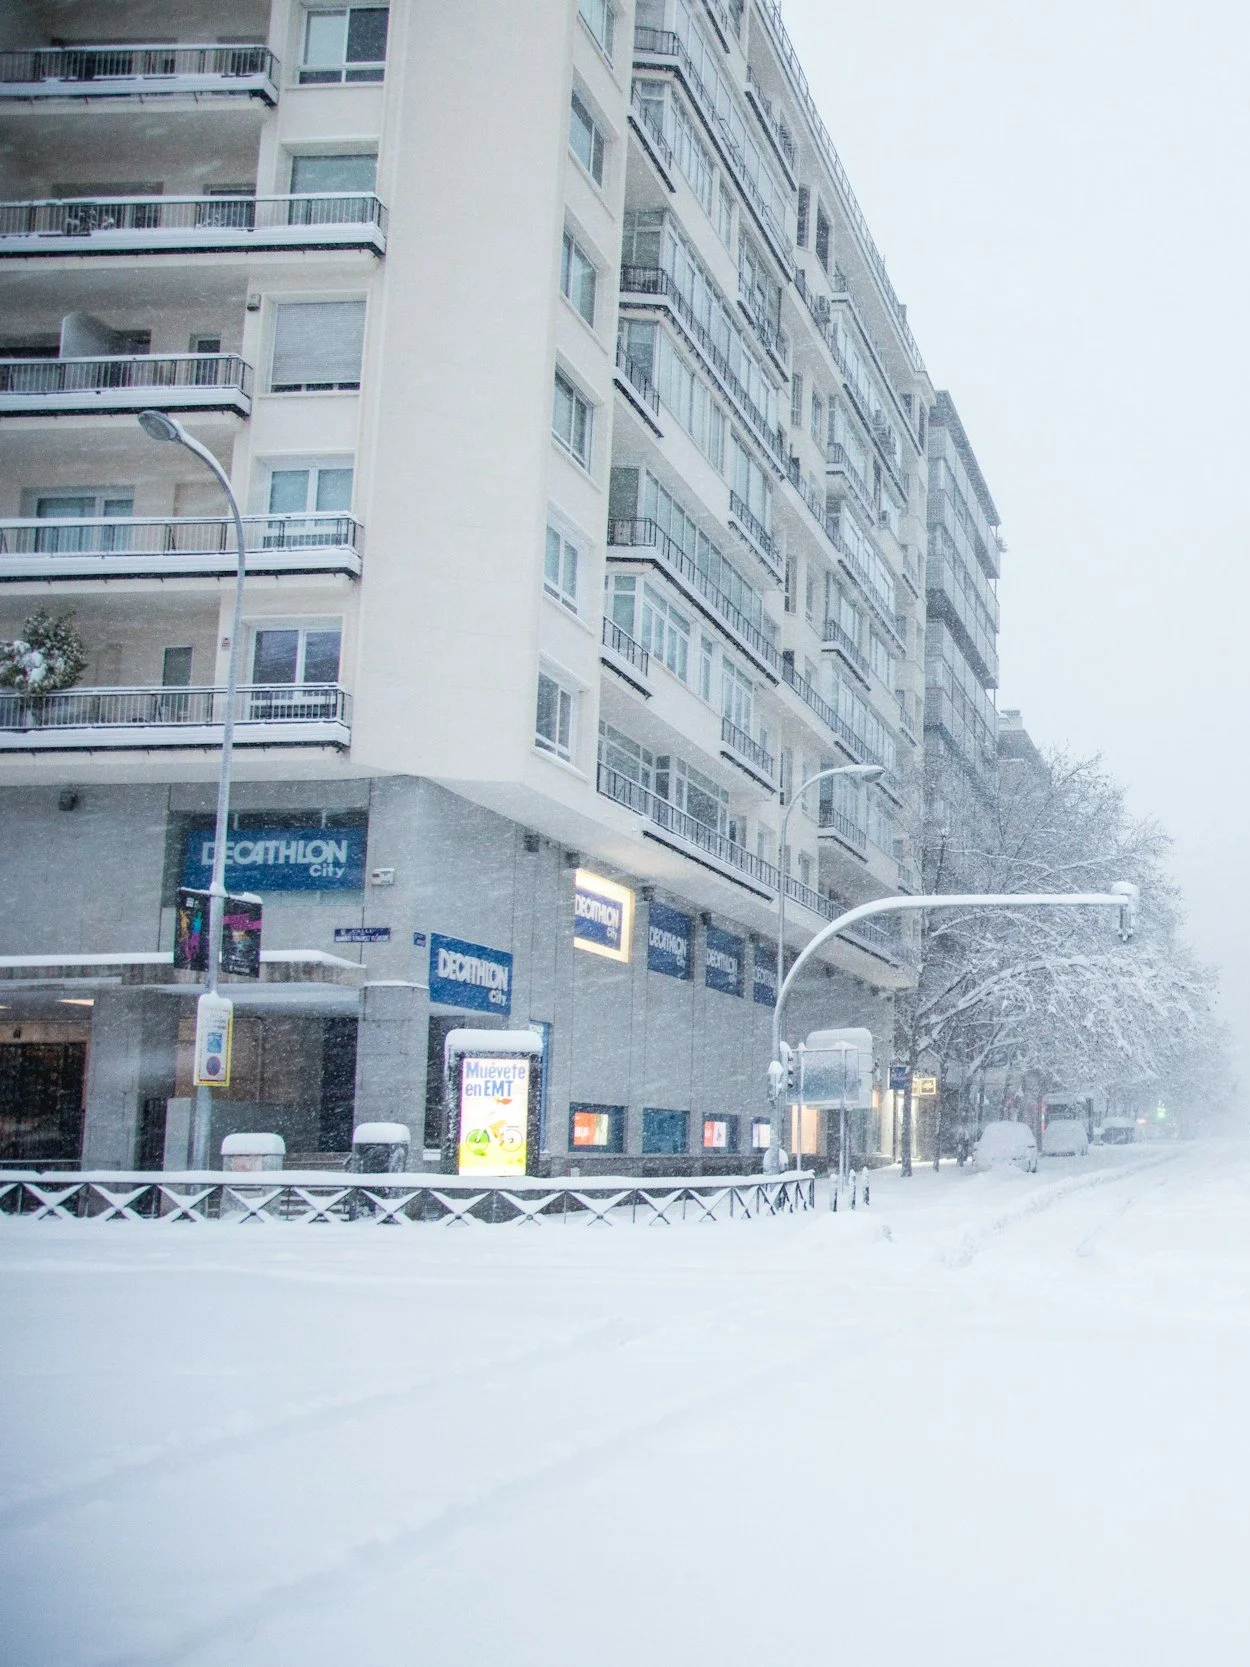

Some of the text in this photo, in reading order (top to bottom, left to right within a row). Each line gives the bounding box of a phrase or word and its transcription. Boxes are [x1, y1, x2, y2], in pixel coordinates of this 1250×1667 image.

[201, 839, 349, 866] DECATHLON
[309, 863, 346, 879] City
[575, 893, 620, 930] DECATHLON
[438, 947, 508, 992] DECATHLON
[465, 1061, 526, 1080] Muévete
[465, 1079, 514, 1097] en EMT
